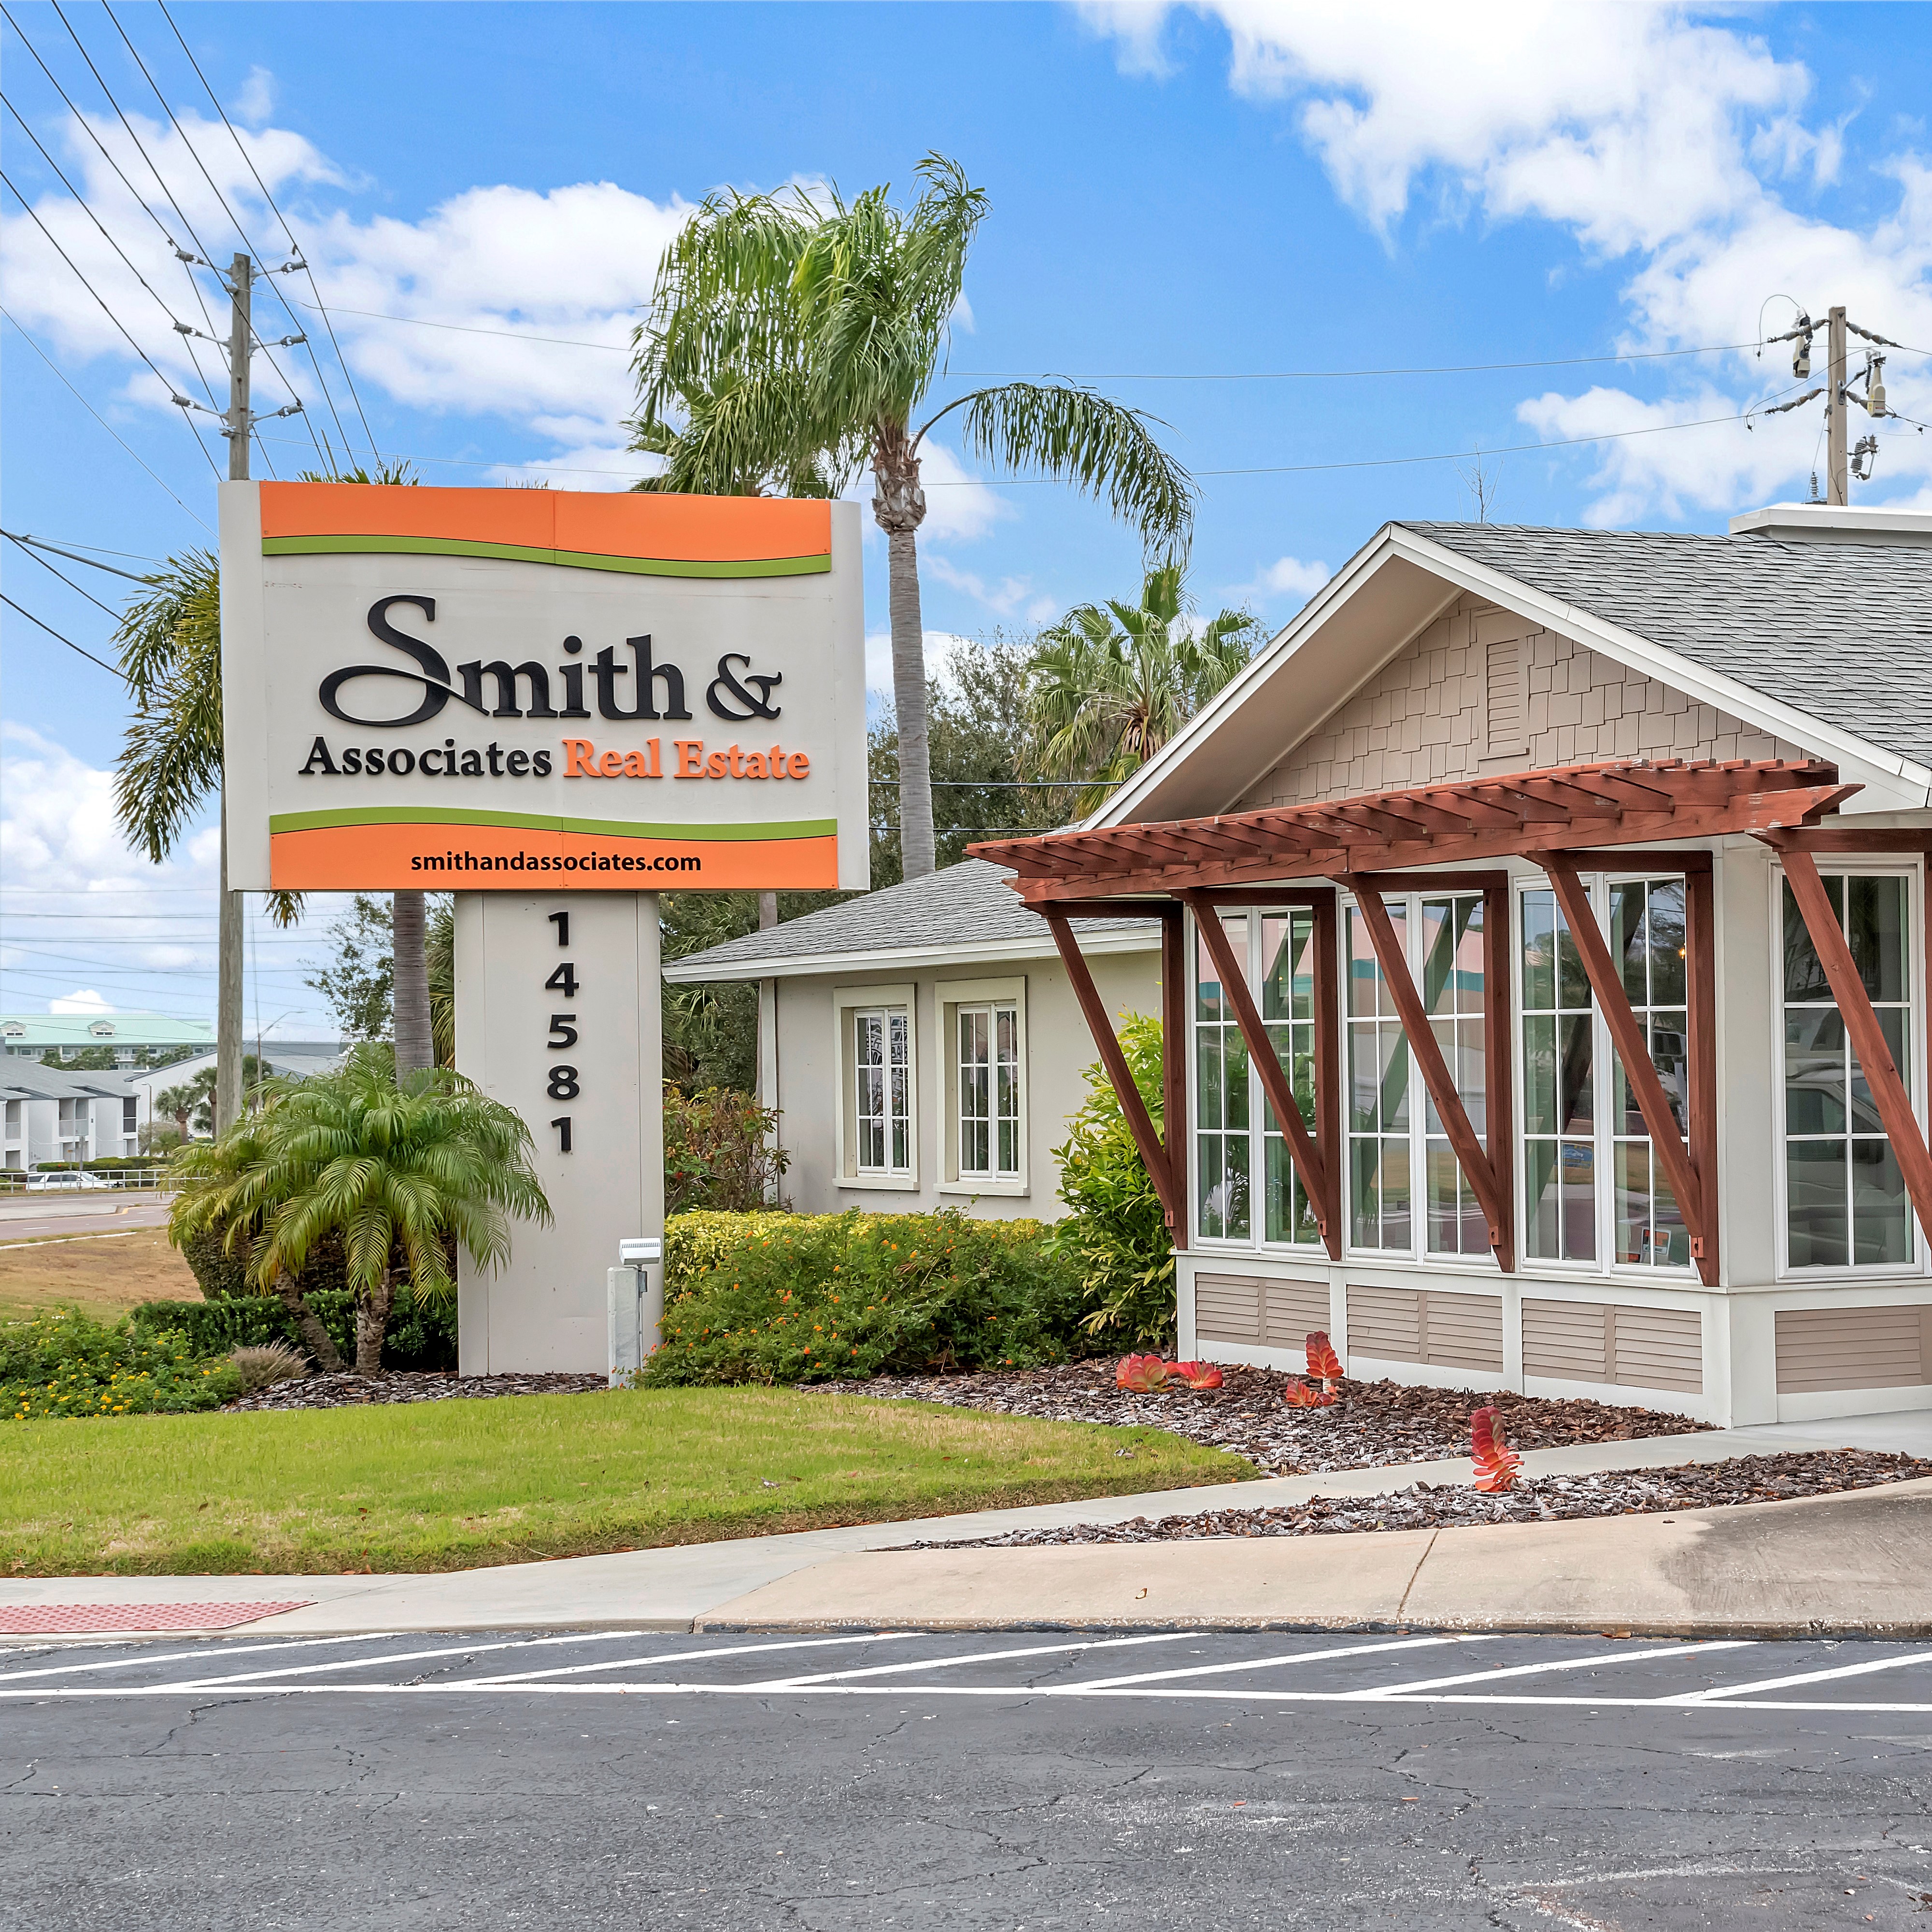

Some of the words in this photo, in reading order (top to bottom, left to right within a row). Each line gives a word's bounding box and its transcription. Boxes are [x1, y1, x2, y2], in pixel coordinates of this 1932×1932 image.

[319, 595, 693, 729] Smith
[706, 653, 783, 722] &
[298, 736, 553, 778] Associates
[562, 739, 664, 779] Real
[673, 741, 810, 780] Estate
[411, 851, 701, 871] smithandassociates.com
